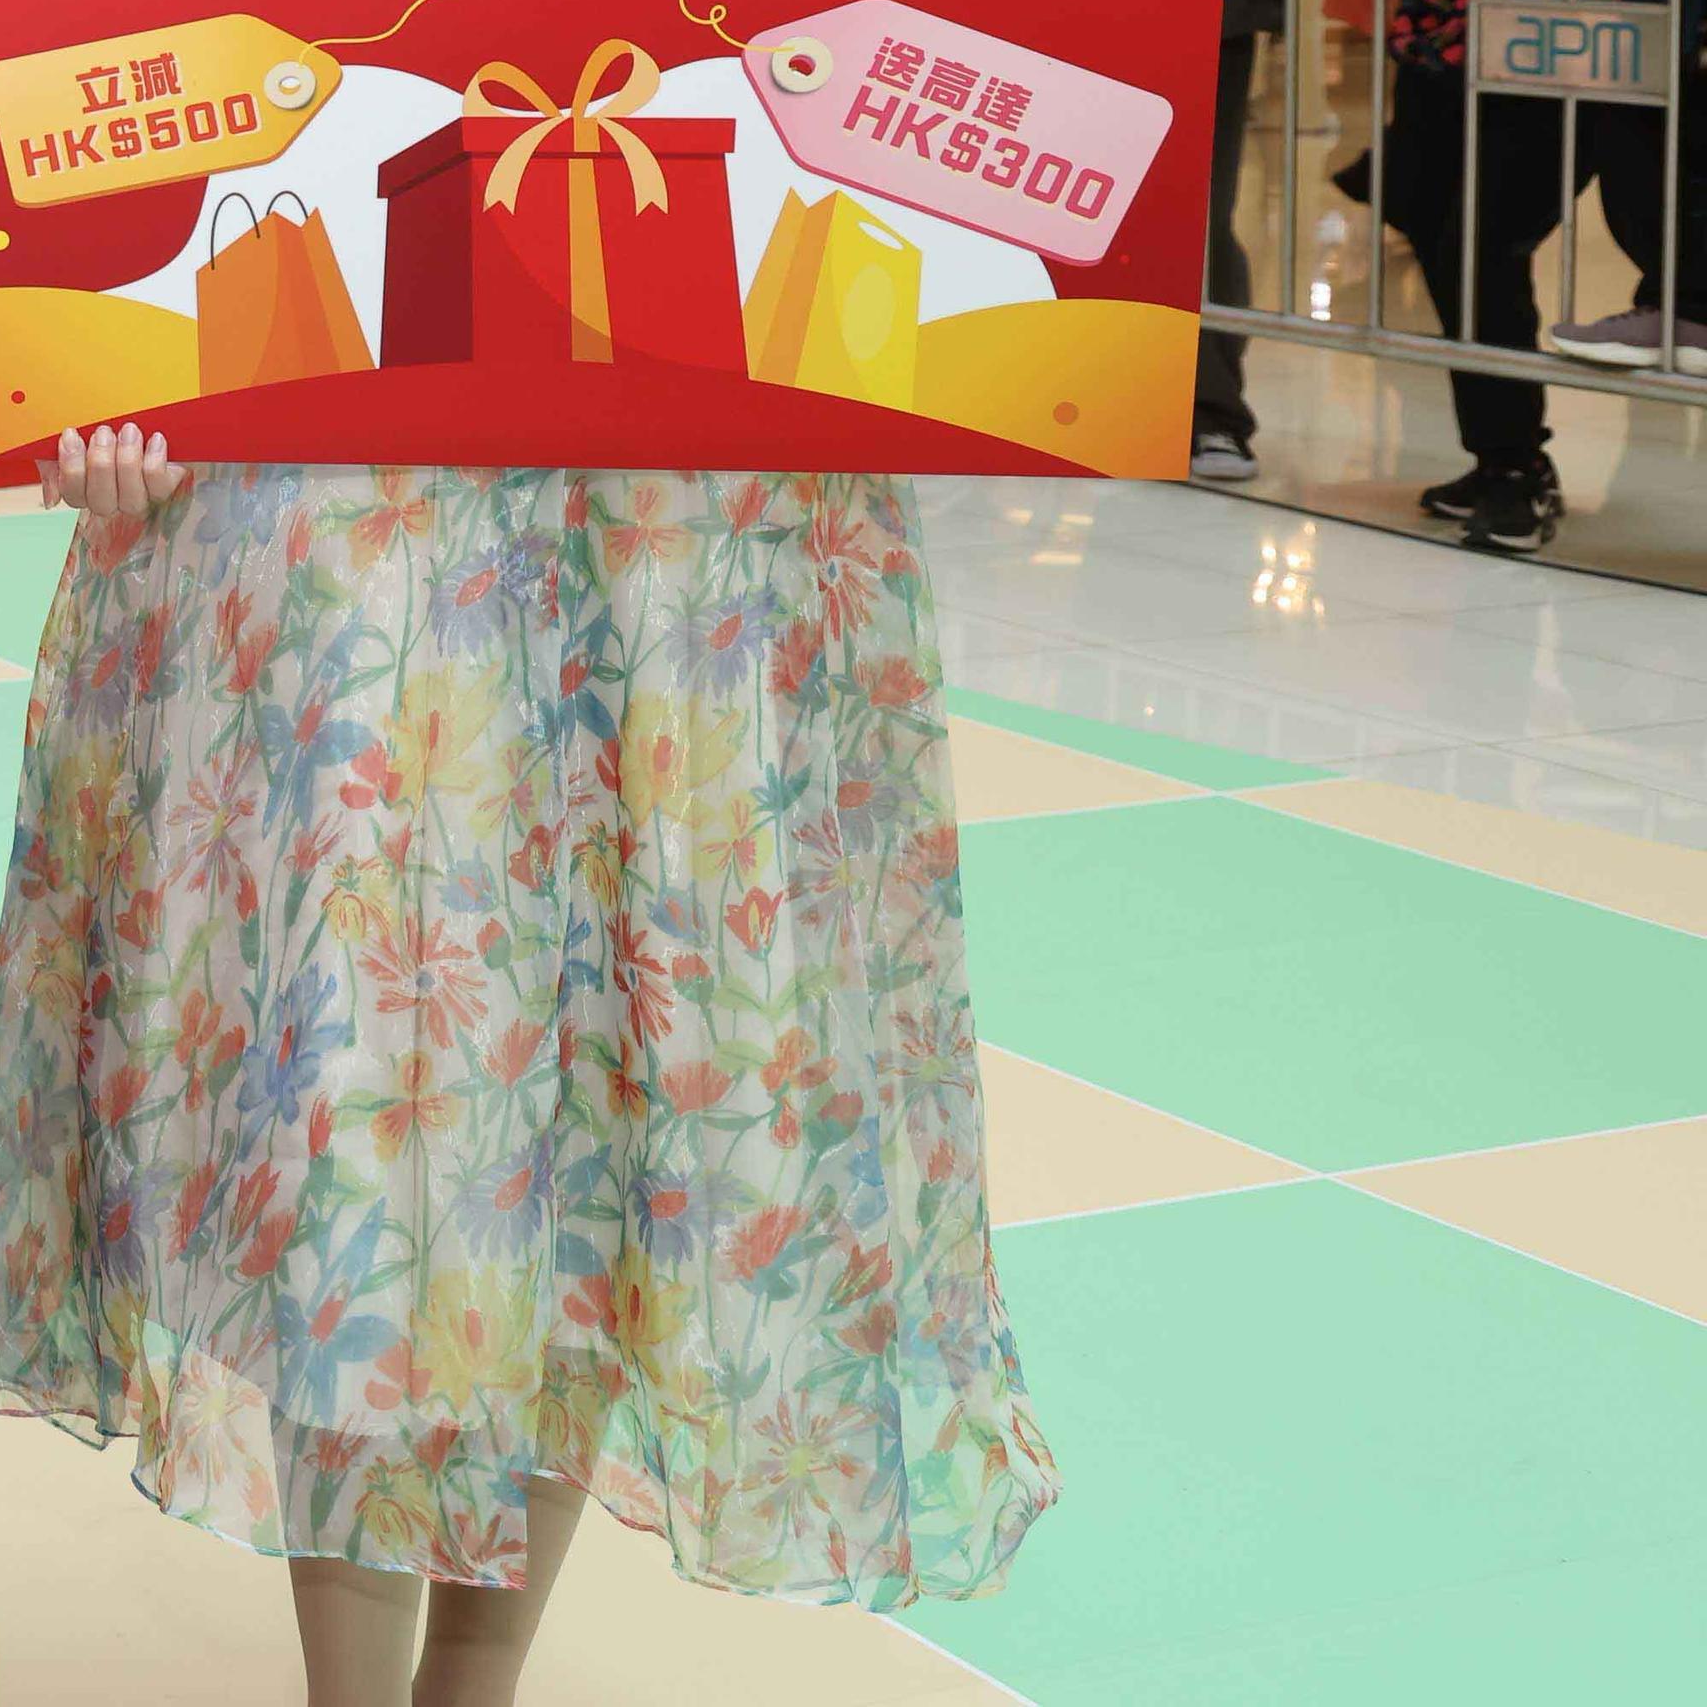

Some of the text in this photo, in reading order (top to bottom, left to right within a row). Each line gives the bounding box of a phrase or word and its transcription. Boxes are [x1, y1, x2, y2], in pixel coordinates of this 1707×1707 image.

[75, 51, 183, 114] 立減
[863, 34, 1034, 135] 送高達
[1504, 14, 1642, 83] apm
[20, 93, 260, 179] HK$500
[844, 86, 1116, 222] HK$300
